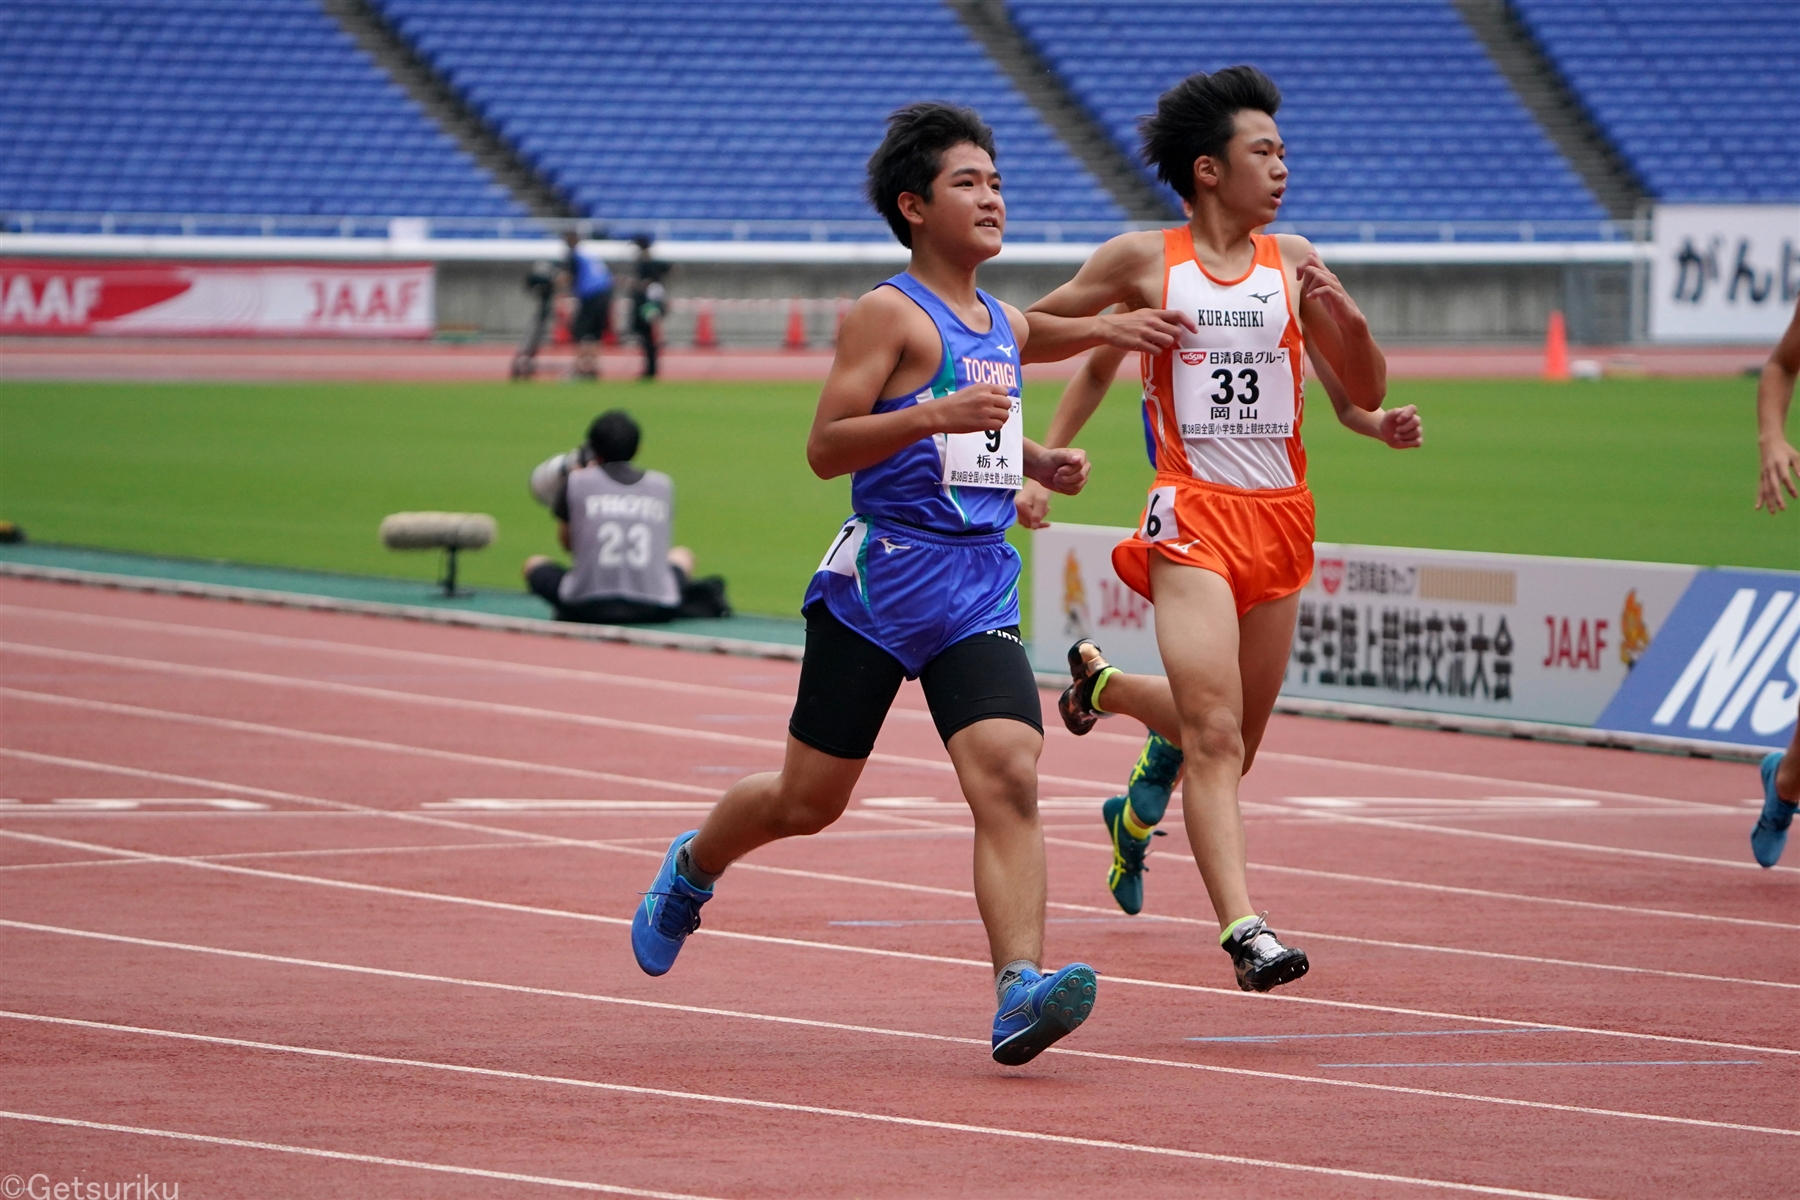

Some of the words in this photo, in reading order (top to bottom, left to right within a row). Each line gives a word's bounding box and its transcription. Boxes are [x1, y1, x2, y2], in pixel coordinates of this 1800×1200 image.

[0, 273, 98, 326] AAF
[308, 279, 421, 322] JAAF
[1197, 309, 1264, 328] KURASHIKI
[962, 356, 1018, 389] TOCHIGI
[1211, 368, 1260, 405] 33
[984, 429, 1002, 453] 9
[1147, 493, 1162, 537] 6
[597, 521, 653, 568] 23
[1284, 602, 1514, 701] 学生陸上競技交流大会
[1542, 614, 1610, 672] JAAF
